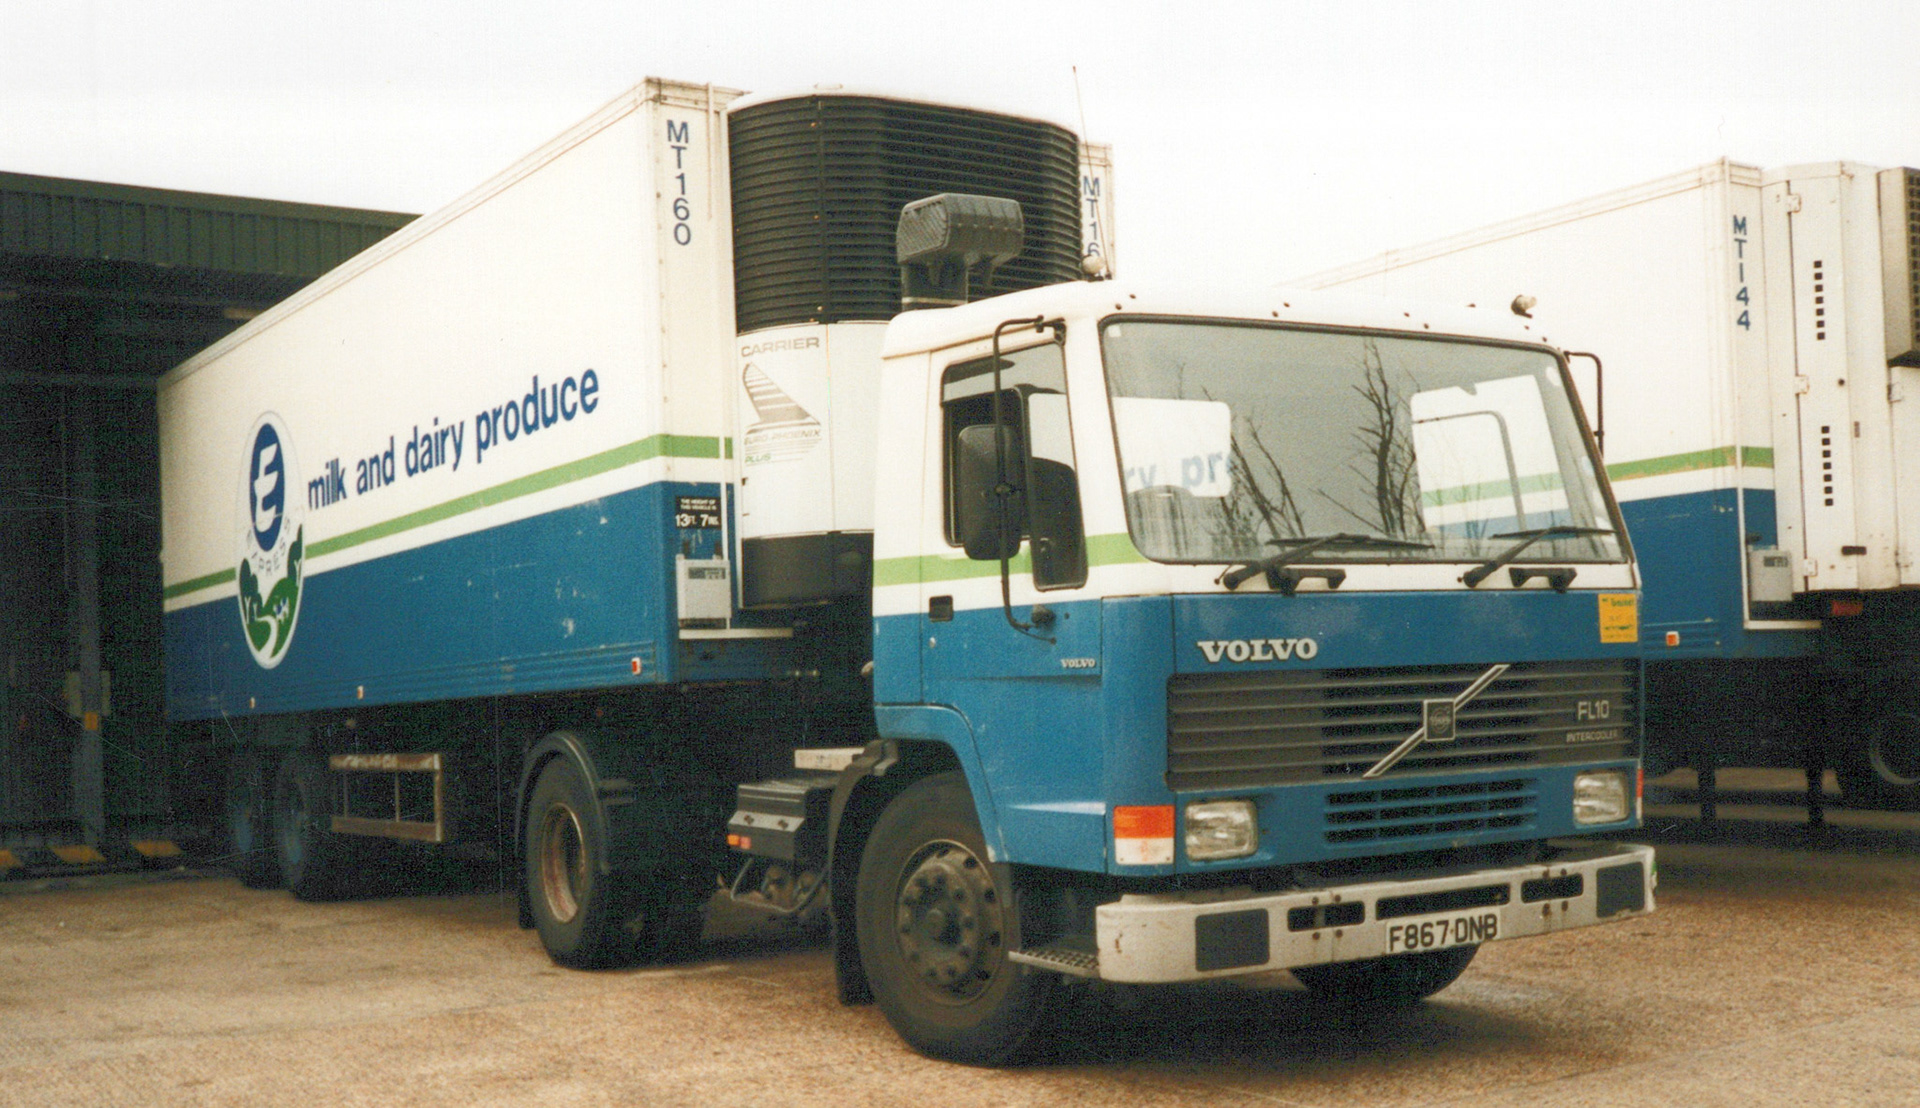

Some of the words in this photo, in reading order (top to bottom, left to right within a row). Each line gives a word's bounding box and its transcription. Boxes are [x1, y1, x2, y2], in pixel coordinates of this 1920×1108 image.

[666, 119, 692, 247] MT160
[1083, 175, 1101, 257] MT16
[741, 336, 820, 358] CARRIER
[307, 456, 347, 511] milk
[356, 434, 396, 496] and
[405, 415, 465, 472] dairy
[476, 367, 600, 464] produce
[1060, 657, 1097, 669] VOLVO
[1197, 637, 1319, 663] VOLVO
[1577, 700, 1610, 720] FL10
